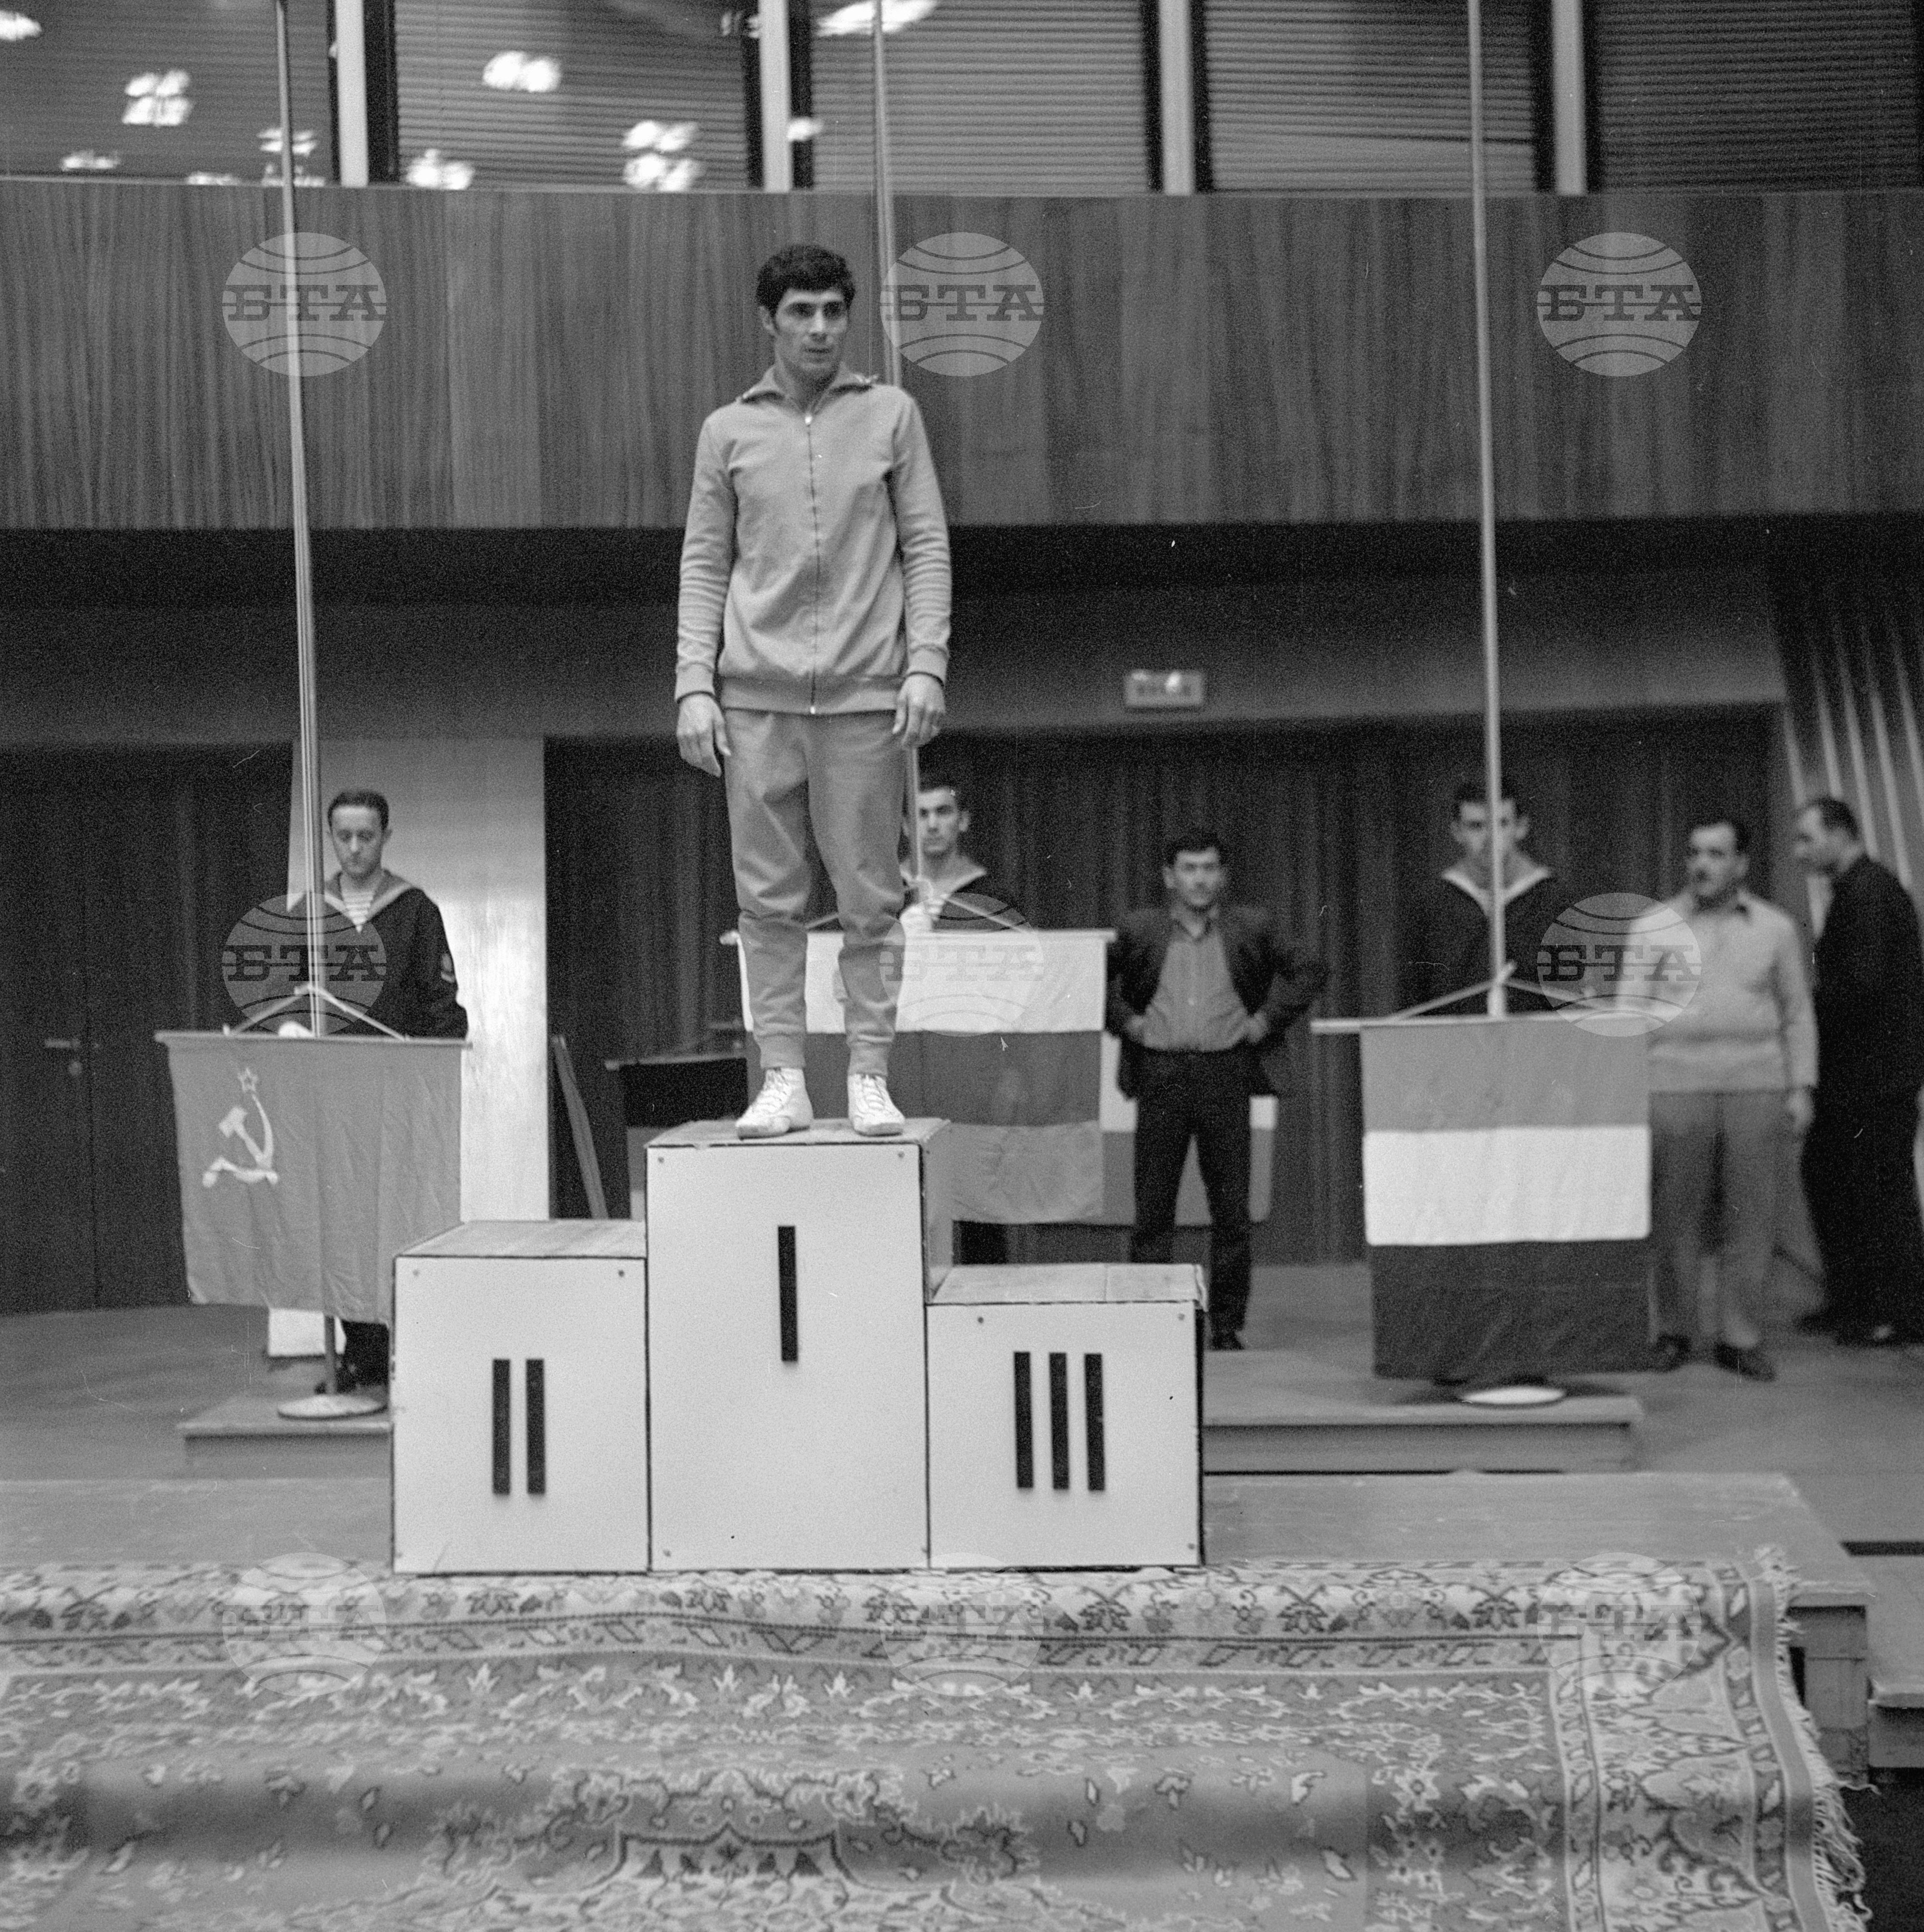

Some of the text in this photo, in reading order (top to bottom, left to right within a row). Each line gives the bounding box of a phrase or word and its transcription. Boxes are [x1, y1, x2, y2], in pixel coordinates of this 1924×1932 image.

[777, 1225, 798, 1364] I
[492, 1358, 546, 1496] II
[1013, 1350, 1106, 1492] III
